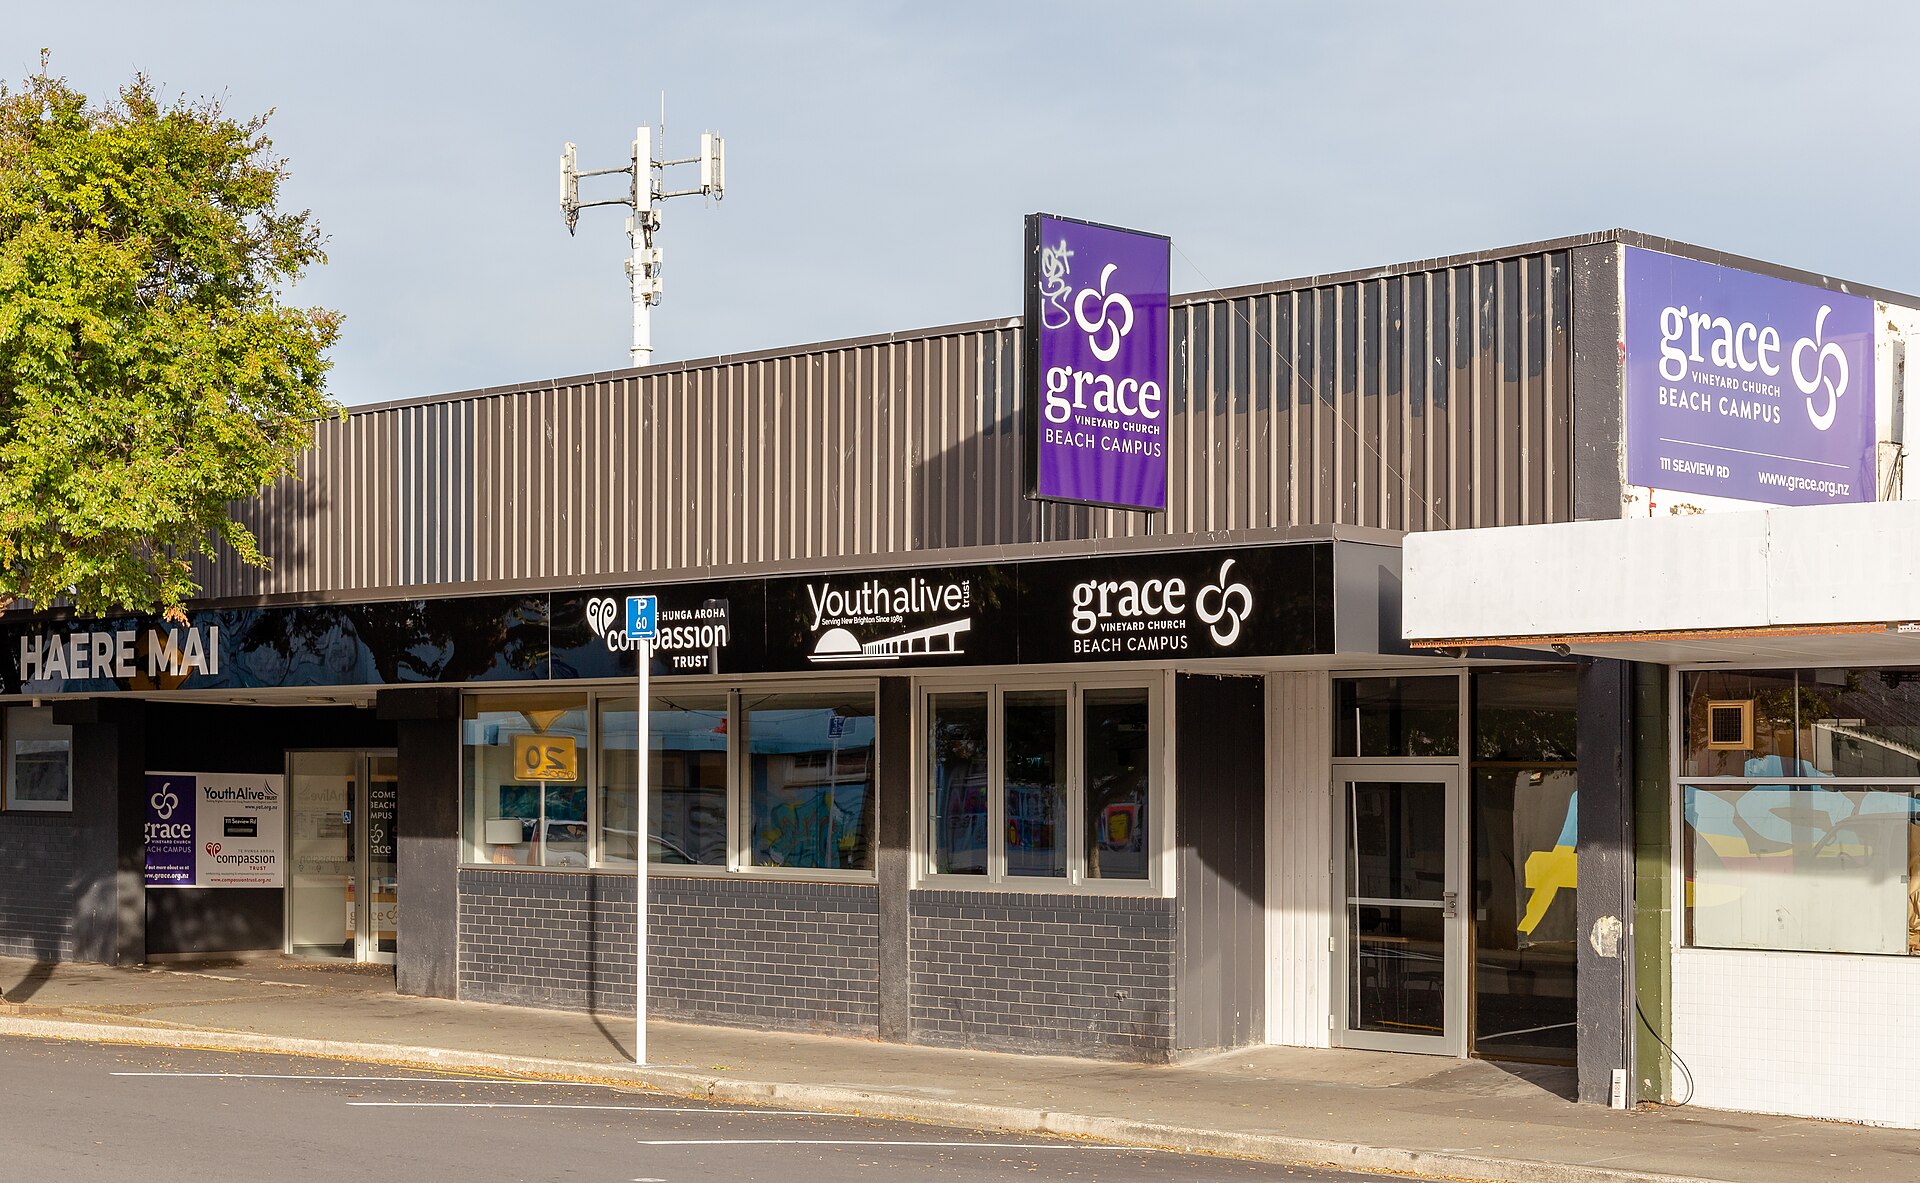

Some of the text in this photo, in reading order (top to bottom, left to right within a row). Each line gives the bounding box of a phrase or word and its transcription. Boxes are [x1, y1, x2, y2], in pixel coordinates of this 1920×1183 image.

[1659, 305, 1780, 382] grace
[1045, 365, 1161, 422] grace
[1692, 370, 1780, 398] VINEYARD CHURCH
[1659, 386, 1780, 424] BEACH CAMPUS
[1075, 414, 1160, 435] VINEYARD CHURCH
[1046, 428, 1161, 458] BEACH CAMPUS
[1660, 457, 1730, 479] 111 SEAVIEW RD
[1758, 471, 1850, 497] www.grace.org.nz
[807, 578, 962, 631] youthalive
[962, 580, 970, 608] trust
[638, 599, 648, 616] P
[662, 610, 692, 621] HUNGA
[695, 608, 726, 619] AROHA
[1072, 578, 1186, 634] grace
[636, 616, 648, 630] 60
[822, 615, 903, 626] Serving New Brighton Since 1989
[1100, 620, 1186, 632] VINEYARD CHURCH
[20, 626, 219, 681] HAERE MAI
[1074, 635, 1188, 654] BEACH CAMPUS
[673, 656, 709, 668] TRUST
[204, 787, 264, 800] YouthAlive
[216, 854, 275, 866] compassion
